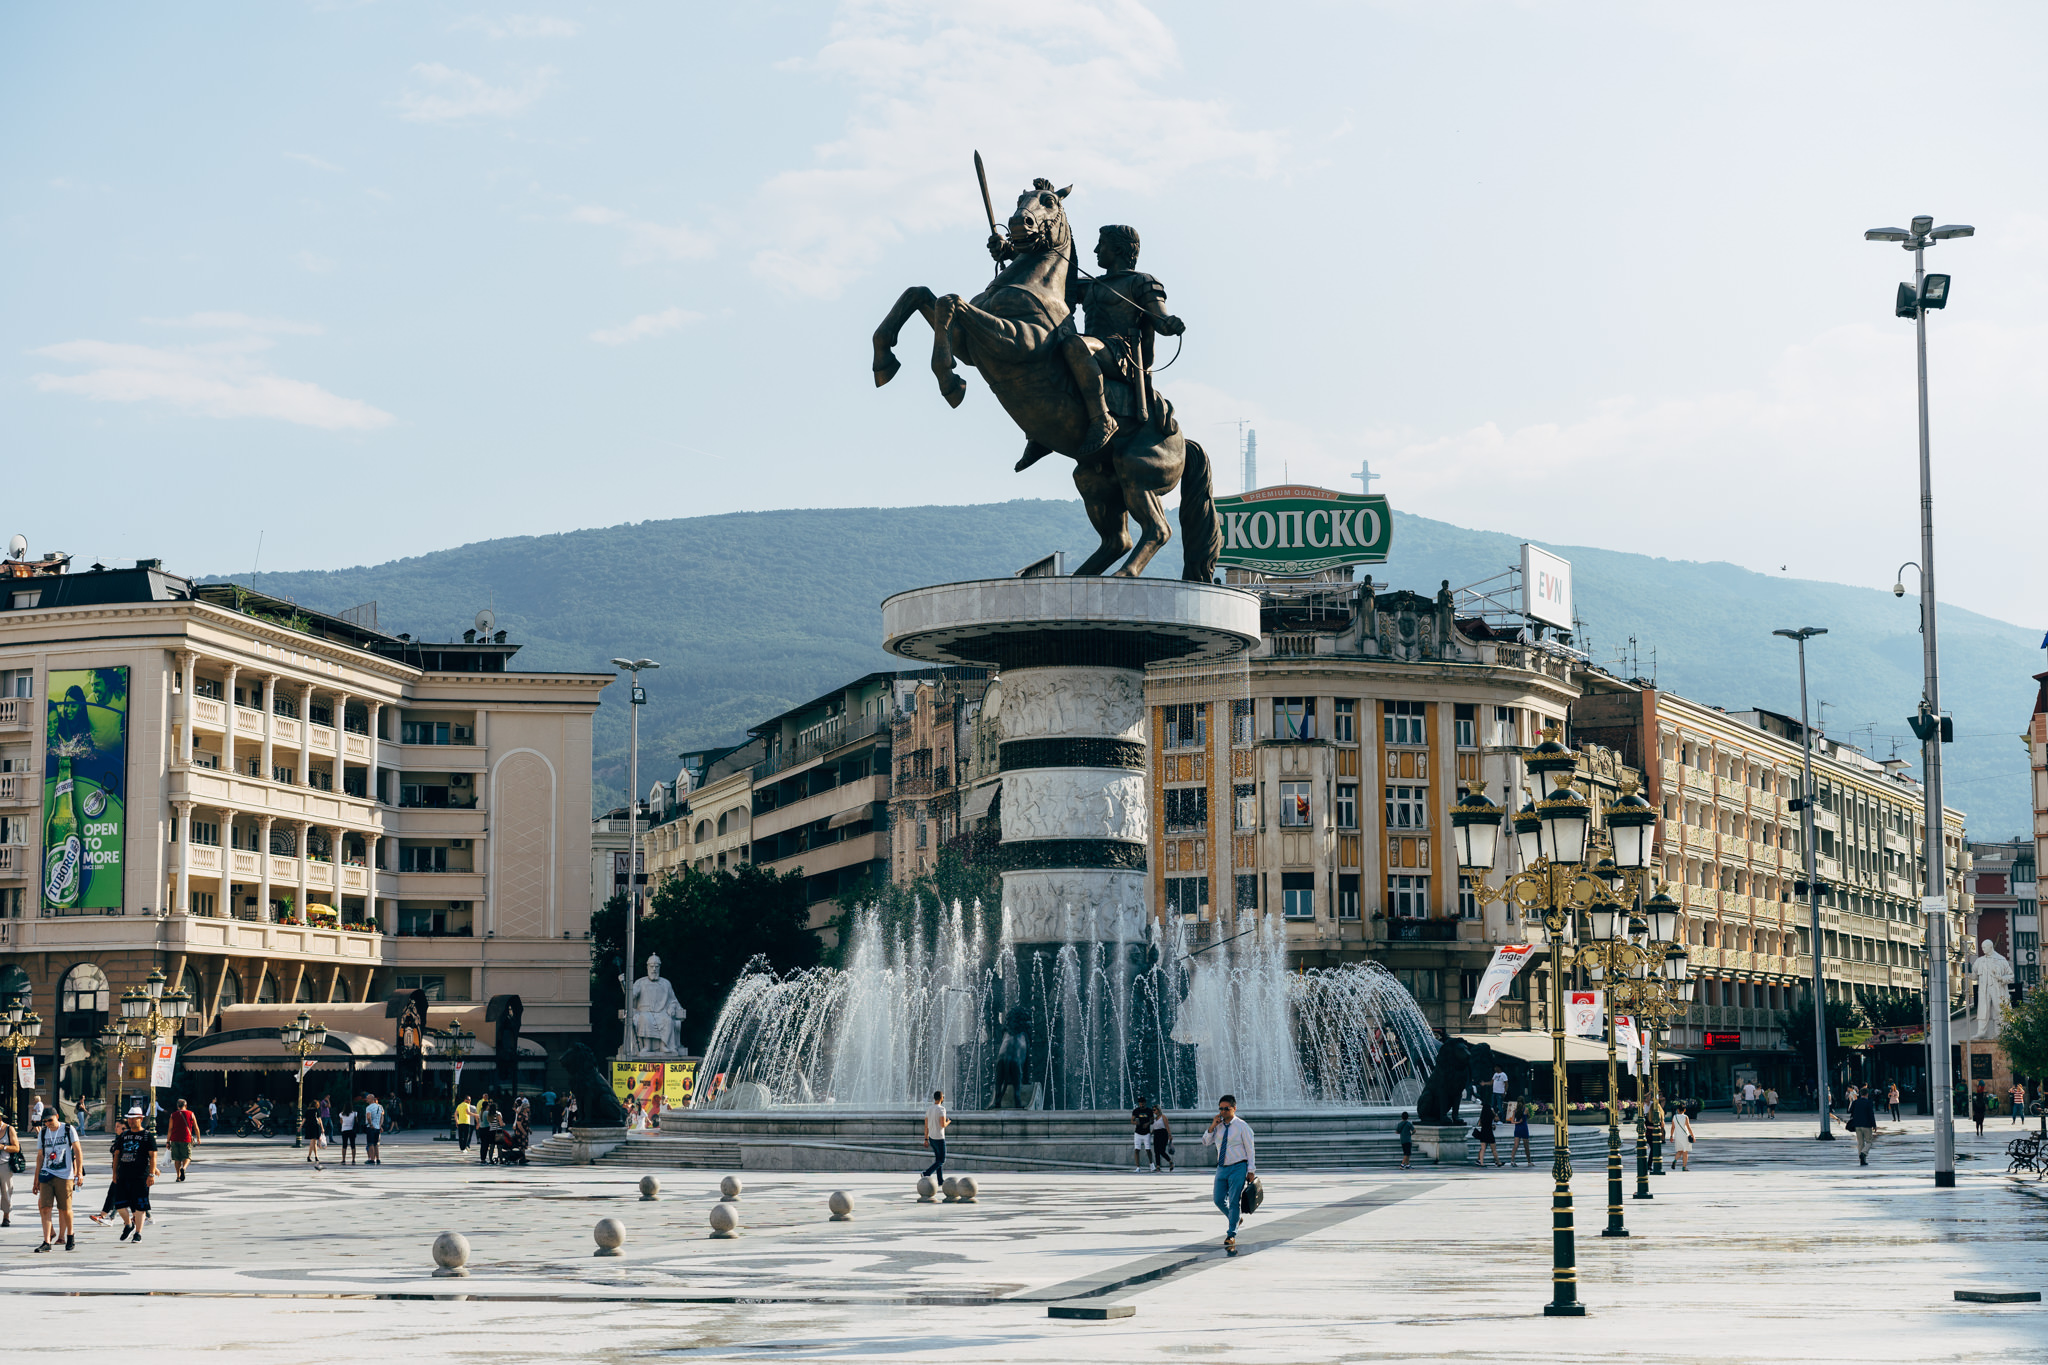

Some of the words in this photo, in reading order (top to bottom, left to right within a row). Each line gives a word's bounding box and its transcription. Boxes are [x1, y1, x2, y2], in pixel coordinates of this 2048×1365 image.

[1250, 489, 1291, 501] PREMIUM
[1294, 489, 1332, 499] QUALITY
[1538, 570, 1562, 605] EVN
[254, 640, 343, 678] ПЕЛИСТЕР
[83, 822, 118, 836] OPEN
[82, 837, 102, 850] TO
[82, 850, 120, 864] MORE
[48, 851, 76, 898] TUBORG
[617, 1063, 637, 1072] SKOPJE
[638, 1063, 661, 1073] CALLING
